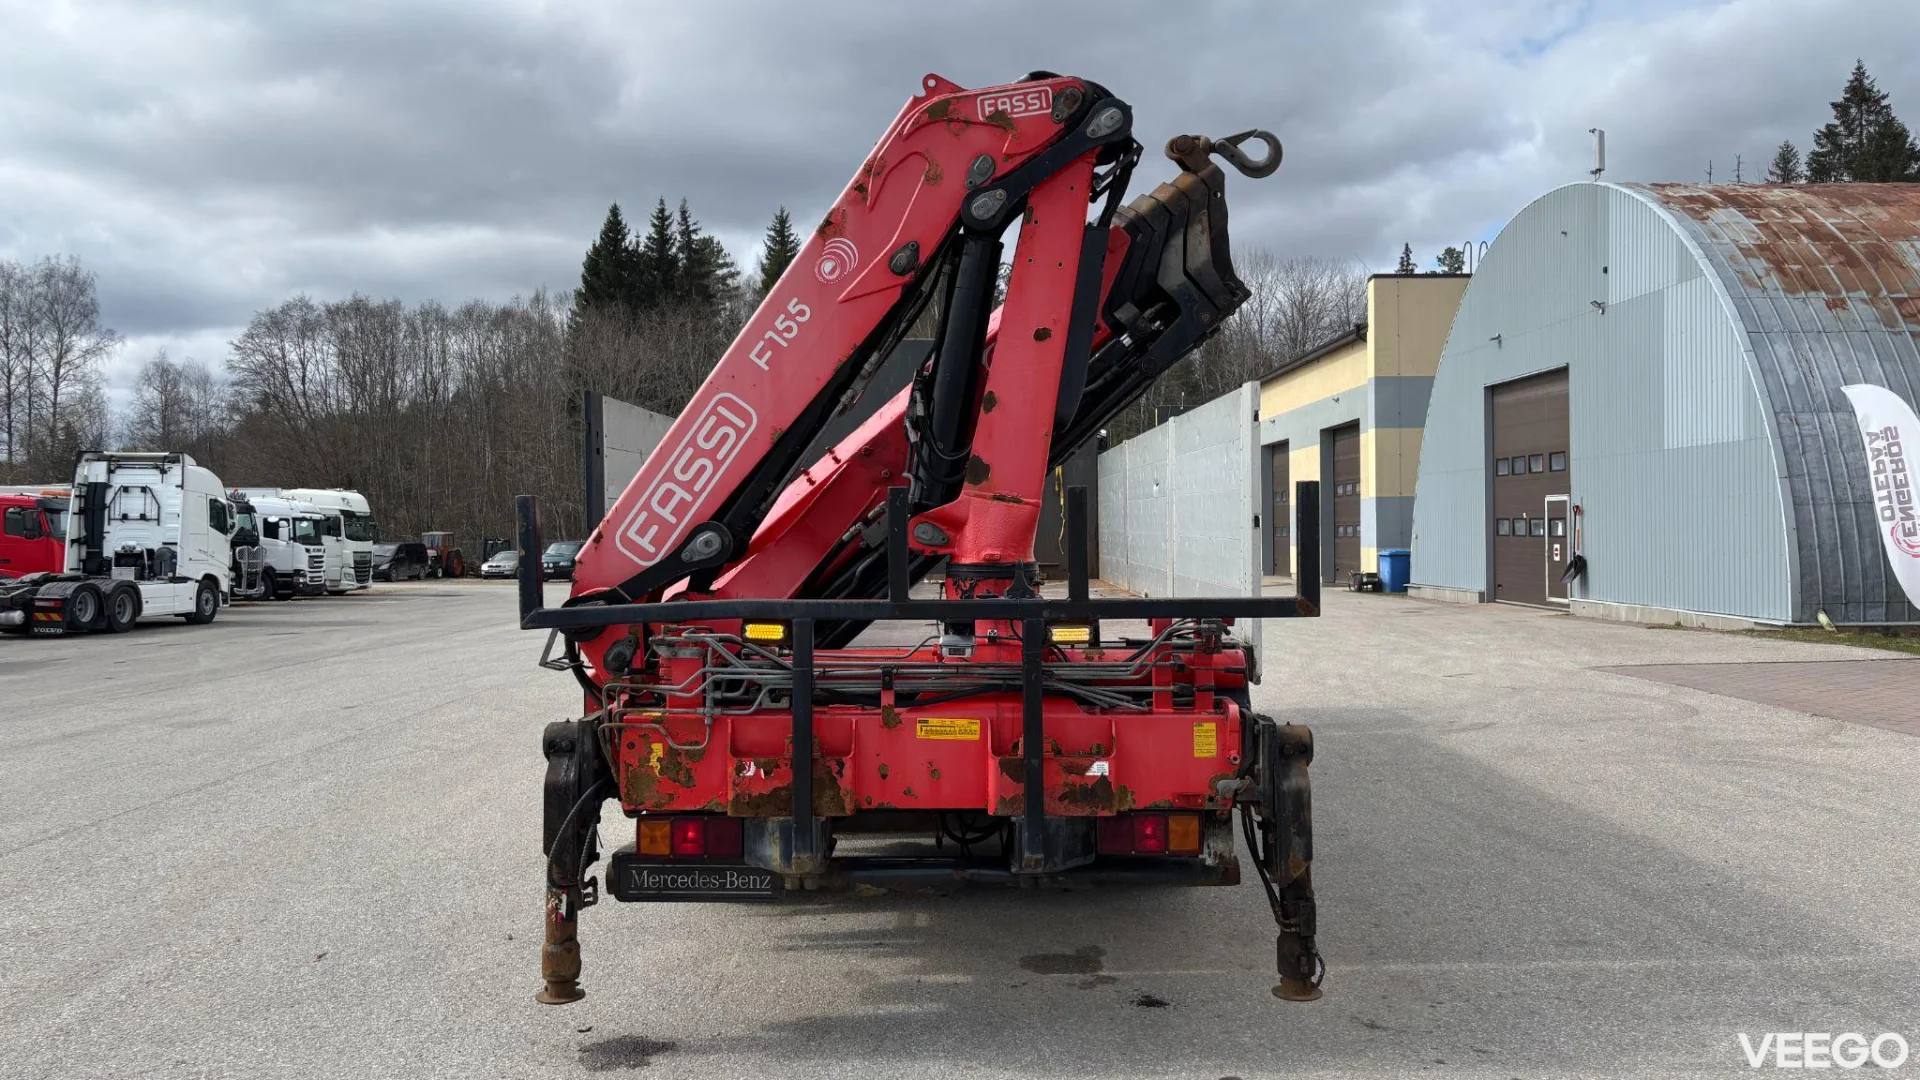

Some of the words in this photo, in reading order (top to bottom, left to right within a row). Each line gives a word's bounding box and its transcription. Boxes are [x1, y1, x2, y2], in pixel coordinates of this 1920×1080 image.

[984, 92, 1046, 116] FASSI
[749, 297, 811, 371] F155
[626, 405, 746, 553] FASSI
[631, 869, 772, 889] Mercedes-Benz
